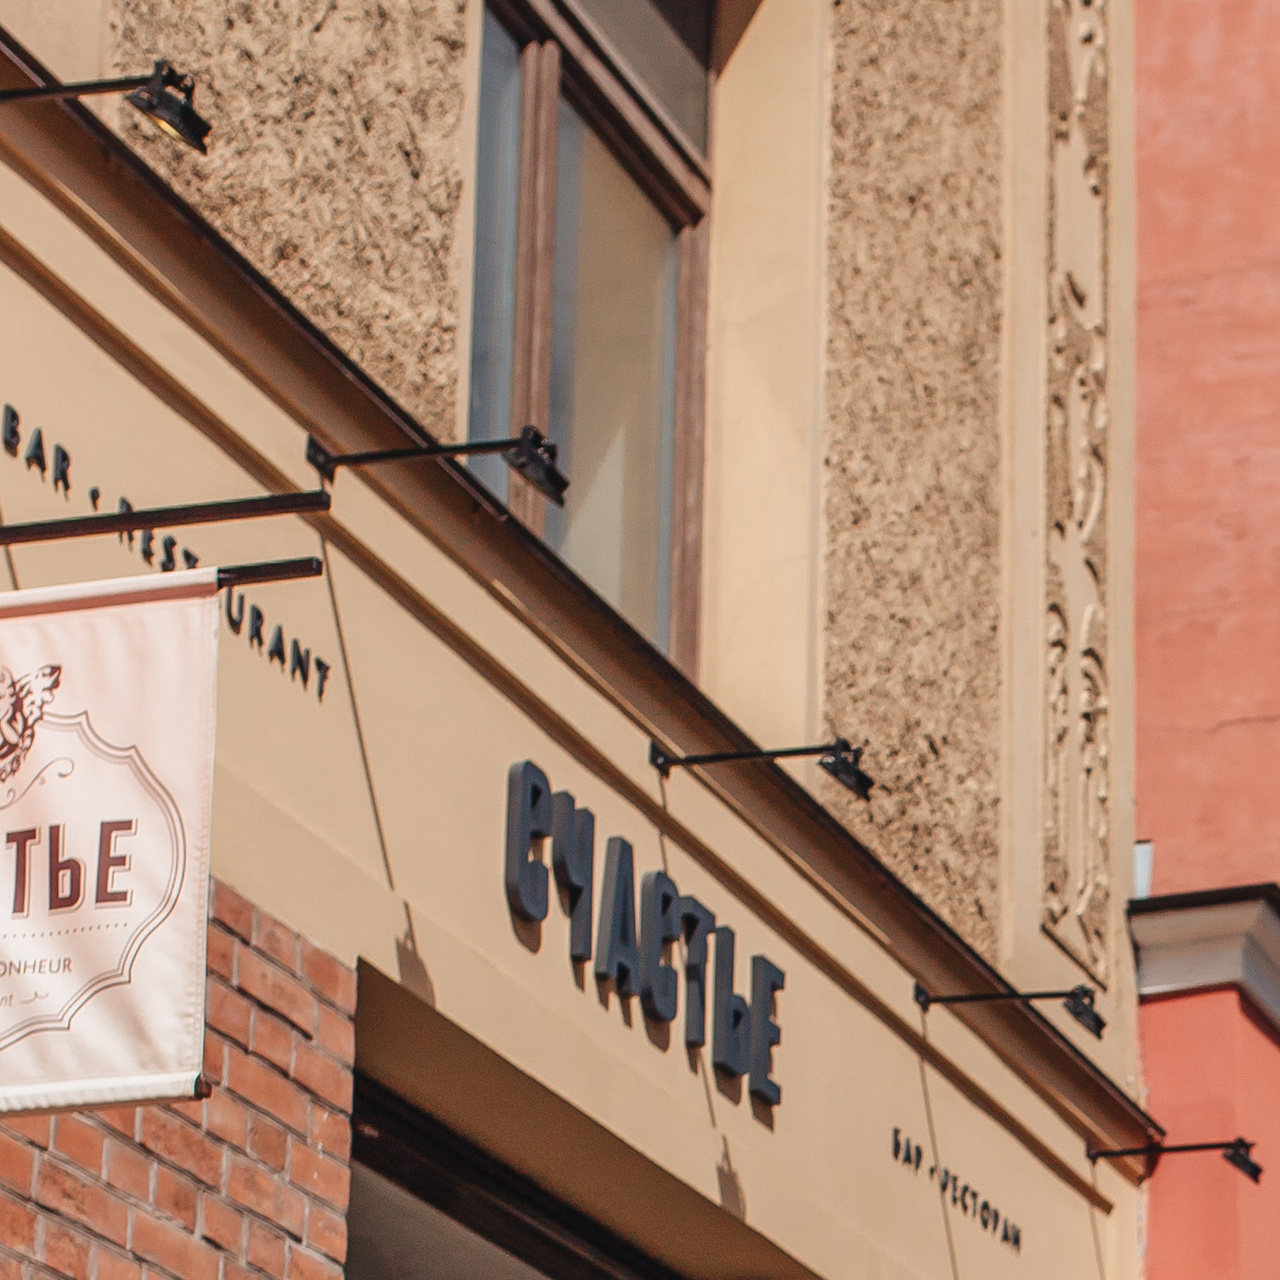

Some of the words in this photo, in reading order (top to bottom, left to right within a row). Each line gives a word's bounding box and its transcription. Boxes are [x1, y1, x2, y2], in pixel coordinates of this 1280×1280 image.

[2, 403, 70, 495] BAR
[504, 759, 785, 1106] СЧАСТЬЕ
[892, 1126, 922, 1171] БАР
[940, 1168, 1021, 1252] РЕСТОРАН
